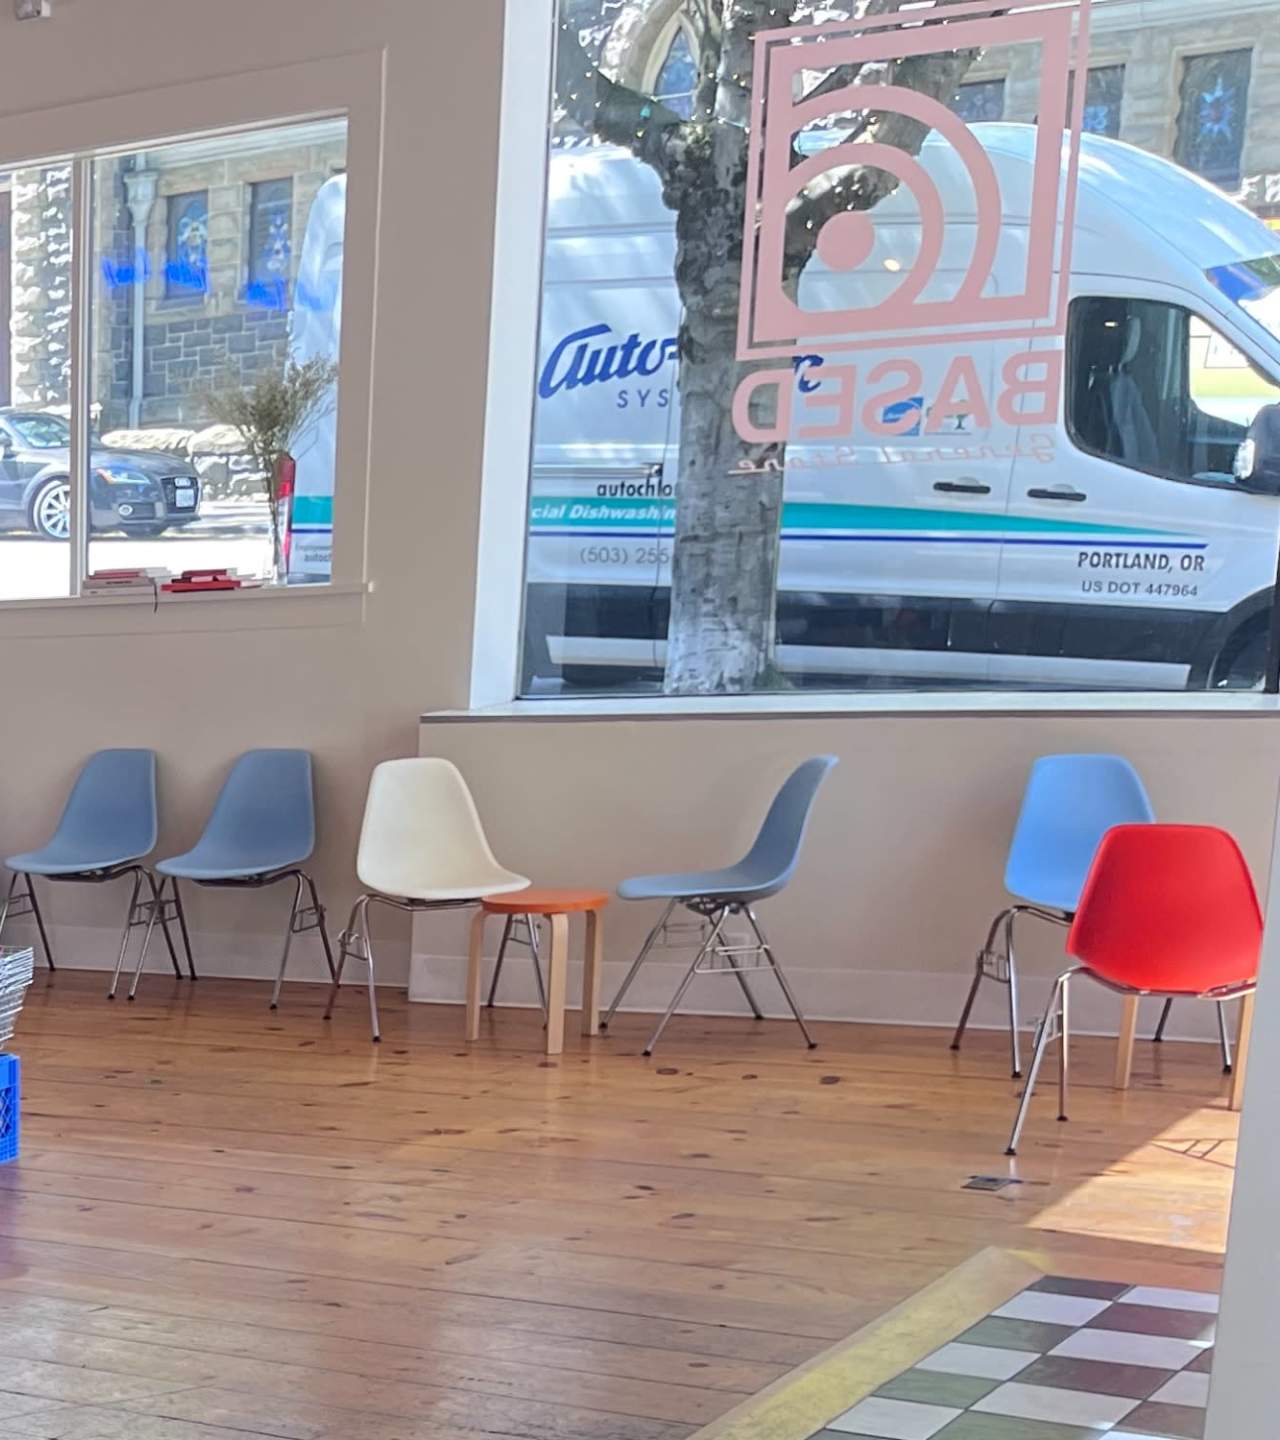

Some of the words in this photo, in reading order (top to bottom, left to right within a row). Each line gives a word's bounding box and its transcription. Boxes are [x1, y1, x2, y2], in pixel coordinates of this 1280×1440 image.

[616, 388, 670, 409] SYS
[596, 476, 674, 497] autochlo
[532, 504, 566, 520] cial
[569, 504, 677, 521] Dishwashin
[580, 546, 629, 565] (503)
[635, 546, 670, 564] 255
[1077, 551, 1173, 574] PORTLAND,
[1180, 554, 1205, 572] OR
[1081, 580, 1103, 593] US
[1107, 580, 1140, 594] DOT
